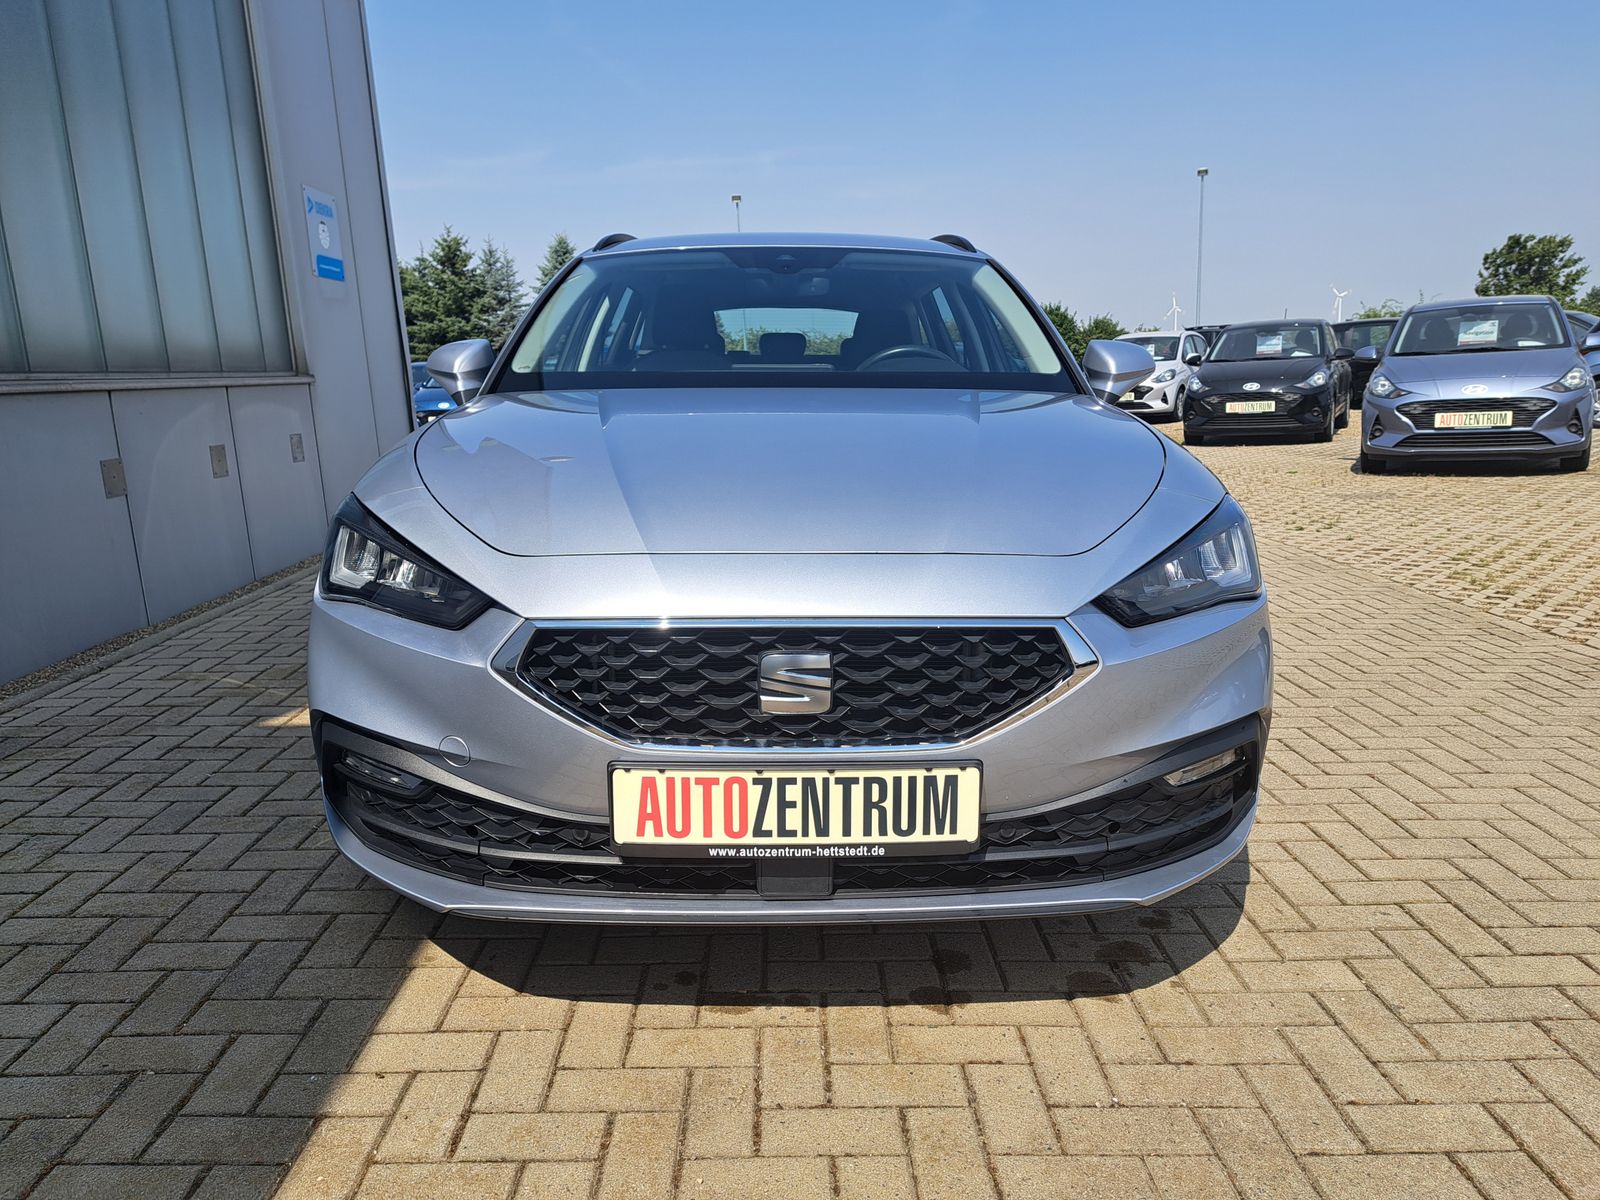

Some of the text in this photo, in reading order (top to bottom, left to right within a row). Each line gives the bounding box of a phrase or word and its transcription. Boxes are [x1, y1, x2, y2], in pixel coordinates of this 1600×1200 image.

[1439, 412, 1508, 426] AUTOZENTRUM
[636, 774, 959, 839] AUTOZENTRUM
[708, 845, 886, 857] www.autozentrum-hettstedt.de
